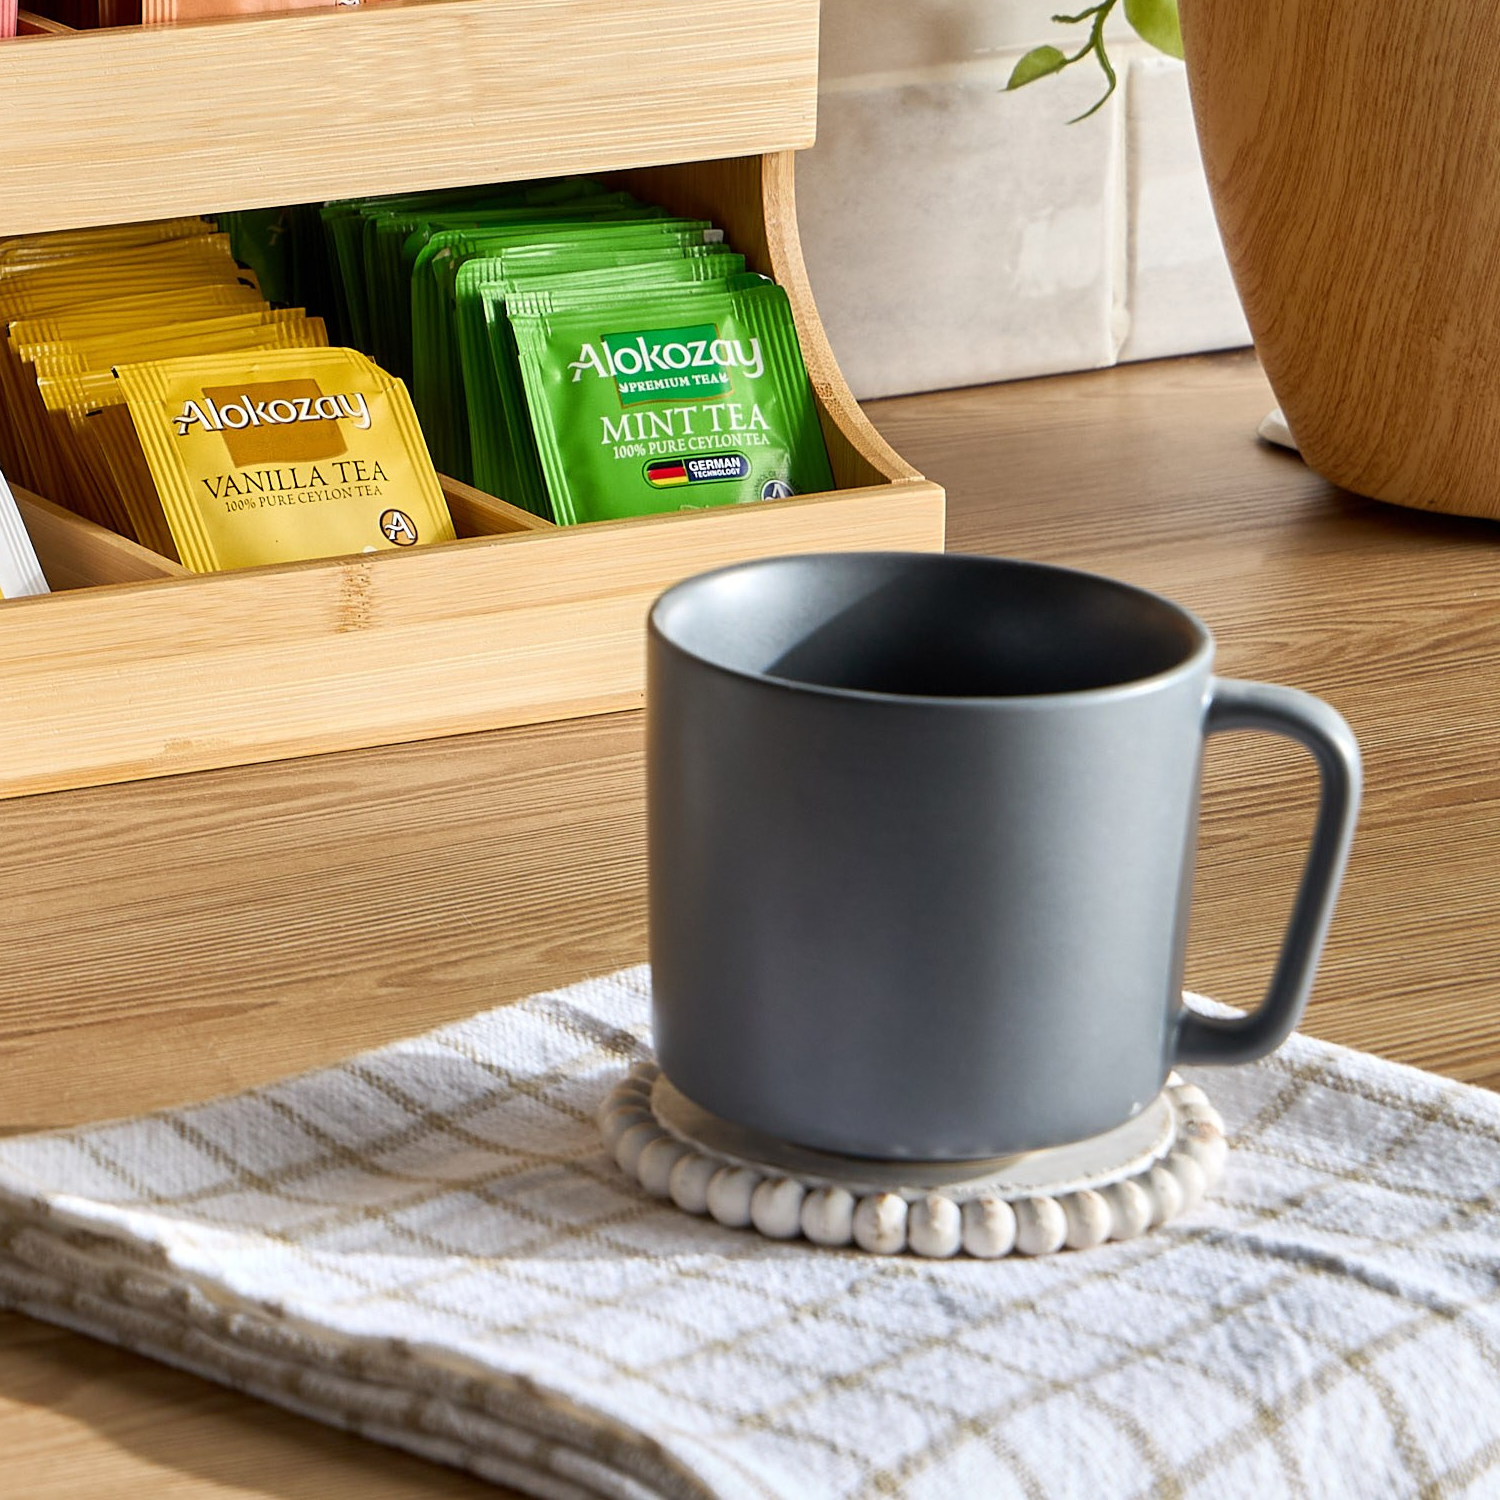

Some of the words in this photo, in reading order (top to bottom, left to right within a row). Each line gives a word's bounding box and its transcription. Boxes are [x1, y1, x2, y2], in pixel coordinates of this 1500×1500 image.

[567, 336, 765, 383] Alokozay
[629, 378, 691, 393] PREMIUM
[692, 374, 720, 385] TEA
[173, 392, 372, 435] Alokozay
[600, 407, 697, 445] MINT
[702, 403, 771, 432] TEA
[613, 444, 646, 460] 100%
[649, 438, 686, 456] PURE
[688, 434, 743, 452] CEYLON
[743, 432, 770, 446] TEA
[688, 457, 741, 472] GERMAN
[693, 467, 741, 479] TECHNOLOGY
[202, 465, 329, 499] VANILLA
[332, 460, 390, 483] TEA
[225, 497, 257, 513] 100%
[259, 492, 296, 508] PURE
[298, 486, 353, 504] CEYLON
[355, 485, 383, 497] TEA
